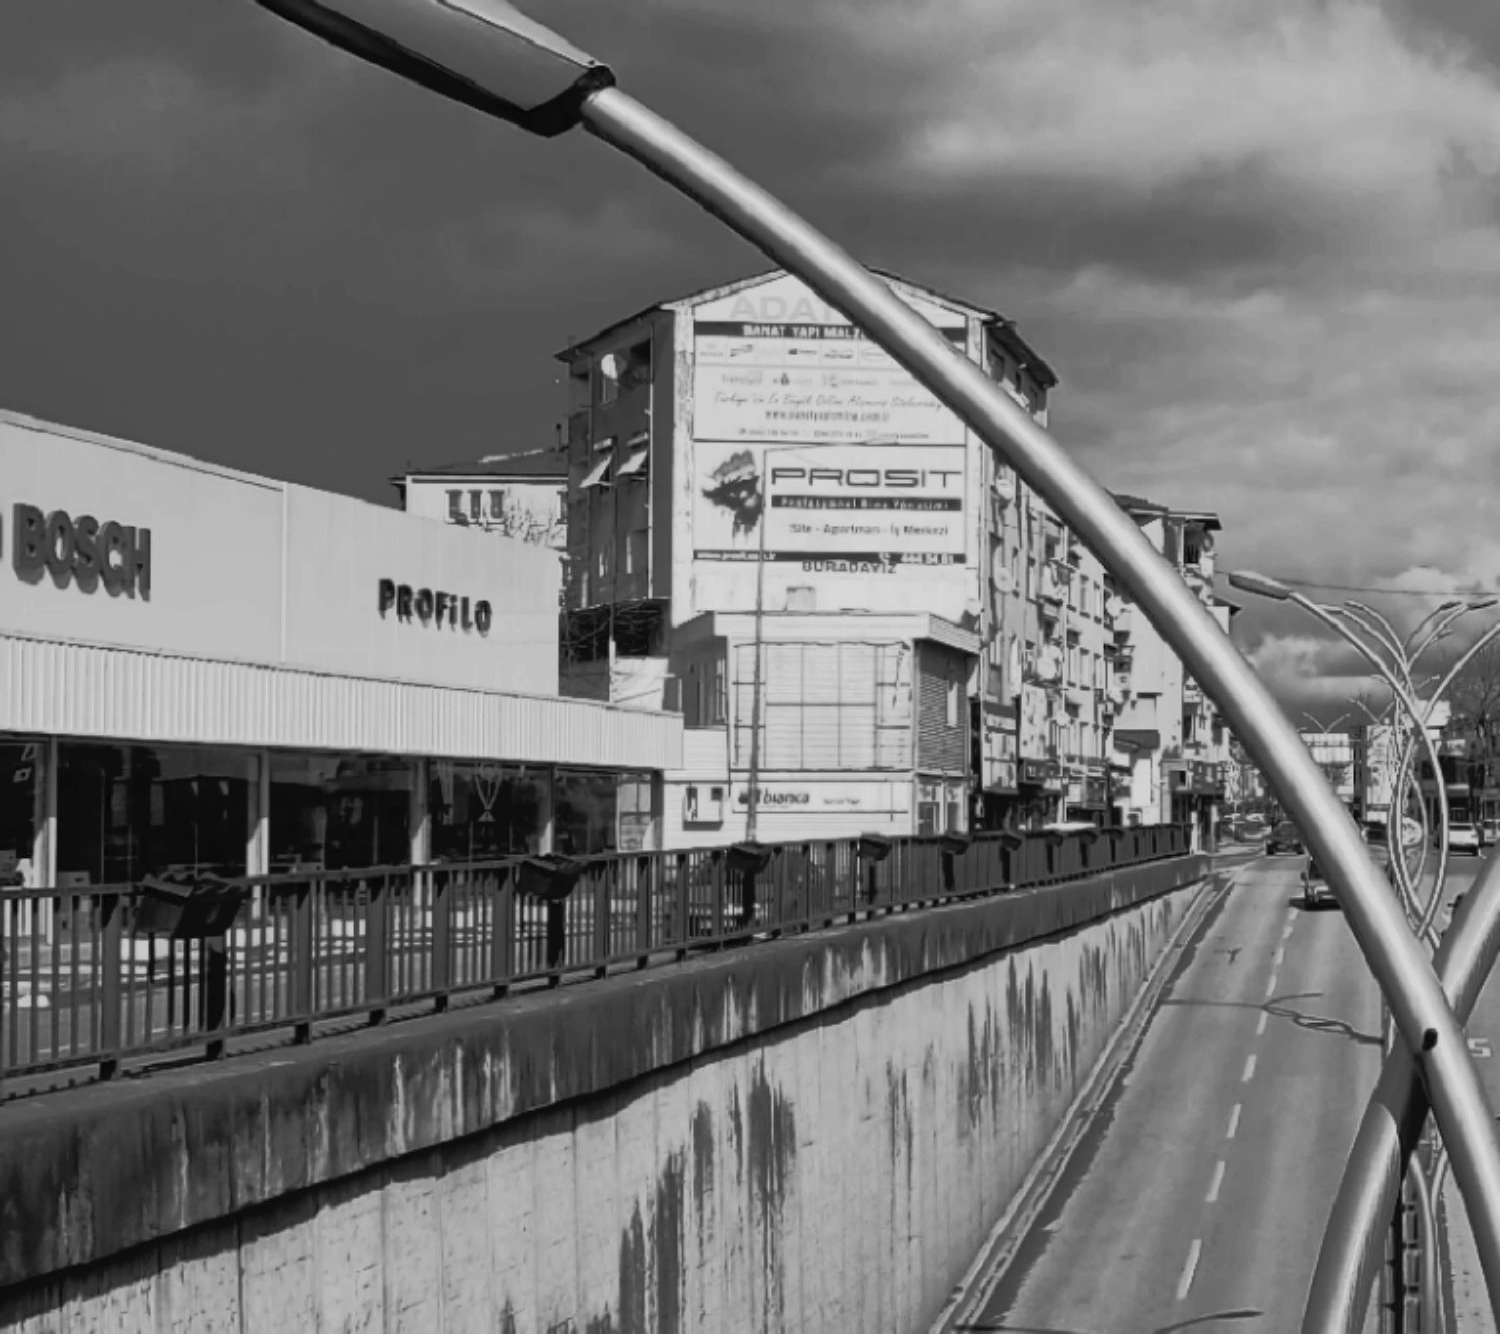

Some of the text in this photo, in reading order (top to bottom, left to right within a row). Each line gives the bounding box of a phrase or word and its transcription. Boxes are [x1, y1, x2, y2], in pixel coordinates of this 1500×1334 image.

[730, 296, 835, 323] ADA
[771, 468, 962, 488] PROSIT
[12, 503, 151, 602] BOSCH
